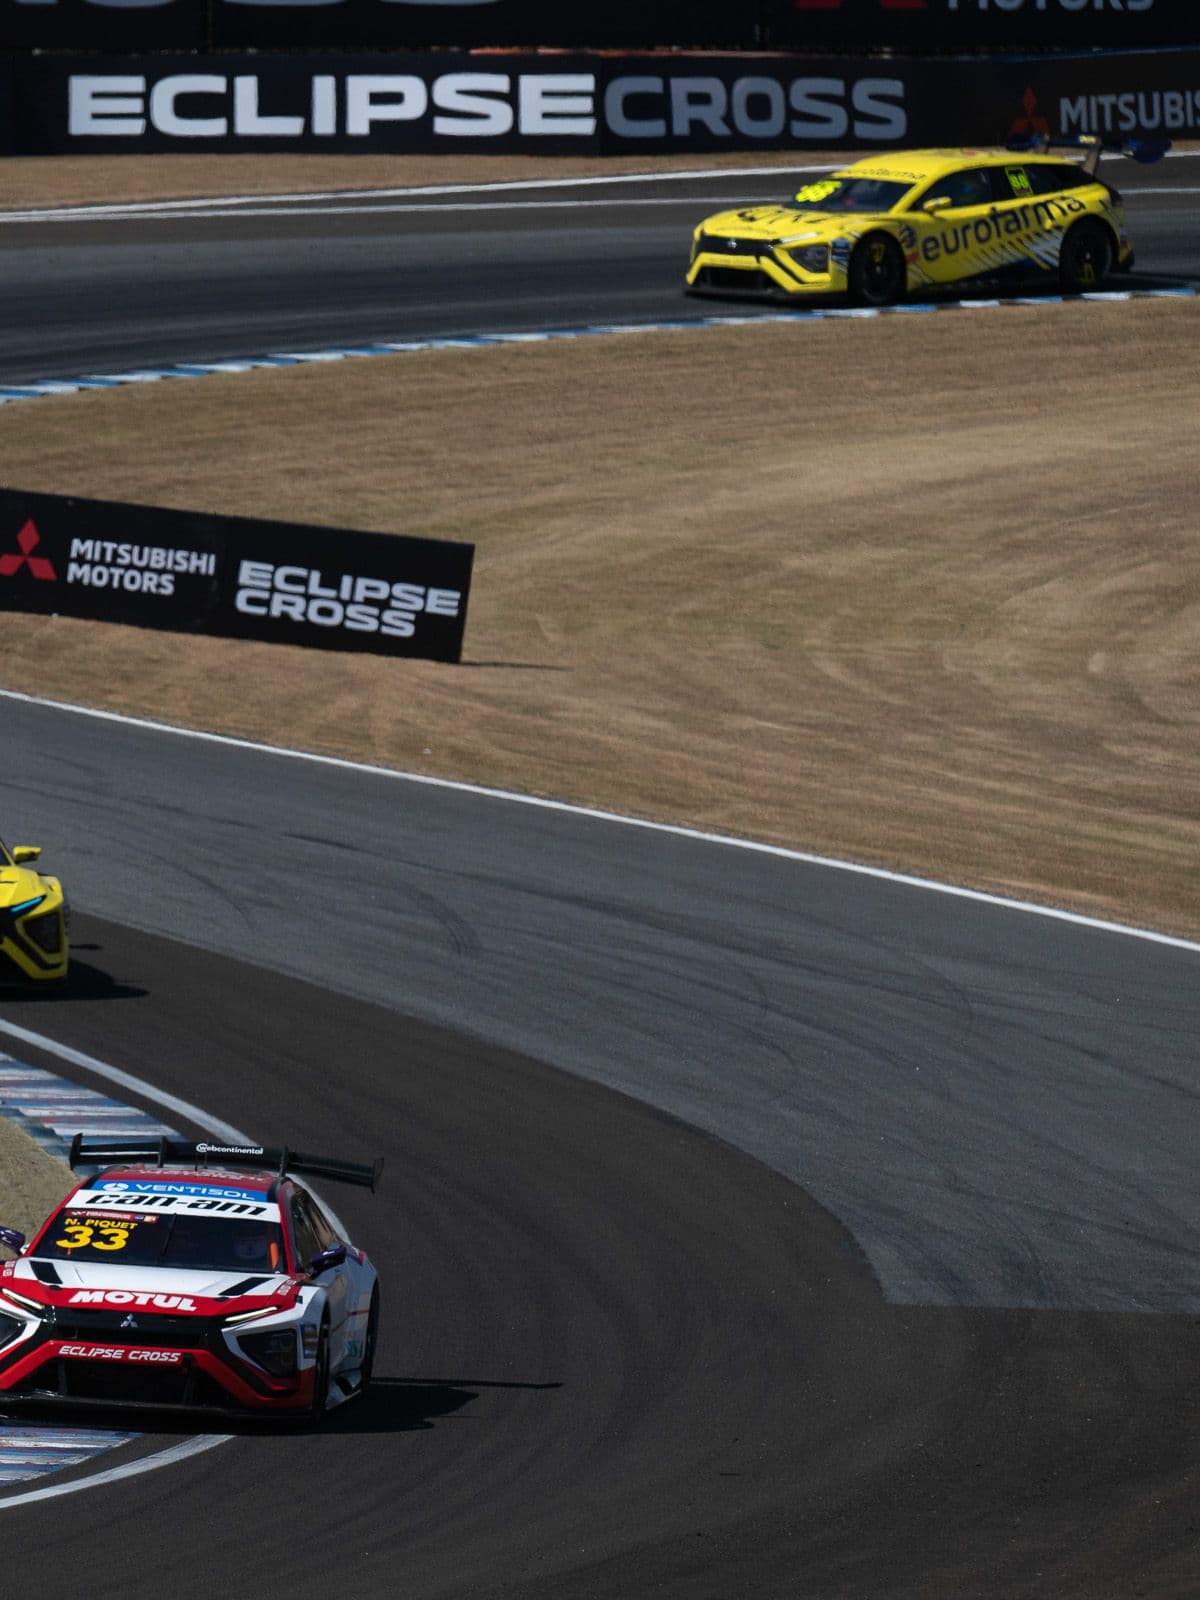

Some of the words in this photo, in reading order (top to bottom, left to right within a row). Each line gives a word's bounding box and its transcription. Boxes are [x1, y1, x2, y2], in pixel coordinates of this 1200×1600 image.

[68, 73, 597, 137] ECLIPSE
[604, 75, 907, 139] CROSS
[70, 537, 217, 577] MITSUBISHI
[66, 562, 176, 597] MOTORS
[238, 559, 462, 617] ECLIPSE
[234, 588, 417, 638] CROSS
[136, 1183, 256, 1201] VENTISOL
[85, 1194, 268, 1216] can-am
[64, 1218, 81, 1227] N.
[85, 1219, 138, 1230] PIQUET
[55, 1225, 130, 1250] 33
[68, 1290, 198, 1312] MOTUL
[59, 1345, 124, 1360] ECLIPSE
[128, 1350, 181, 1363] CROSS
